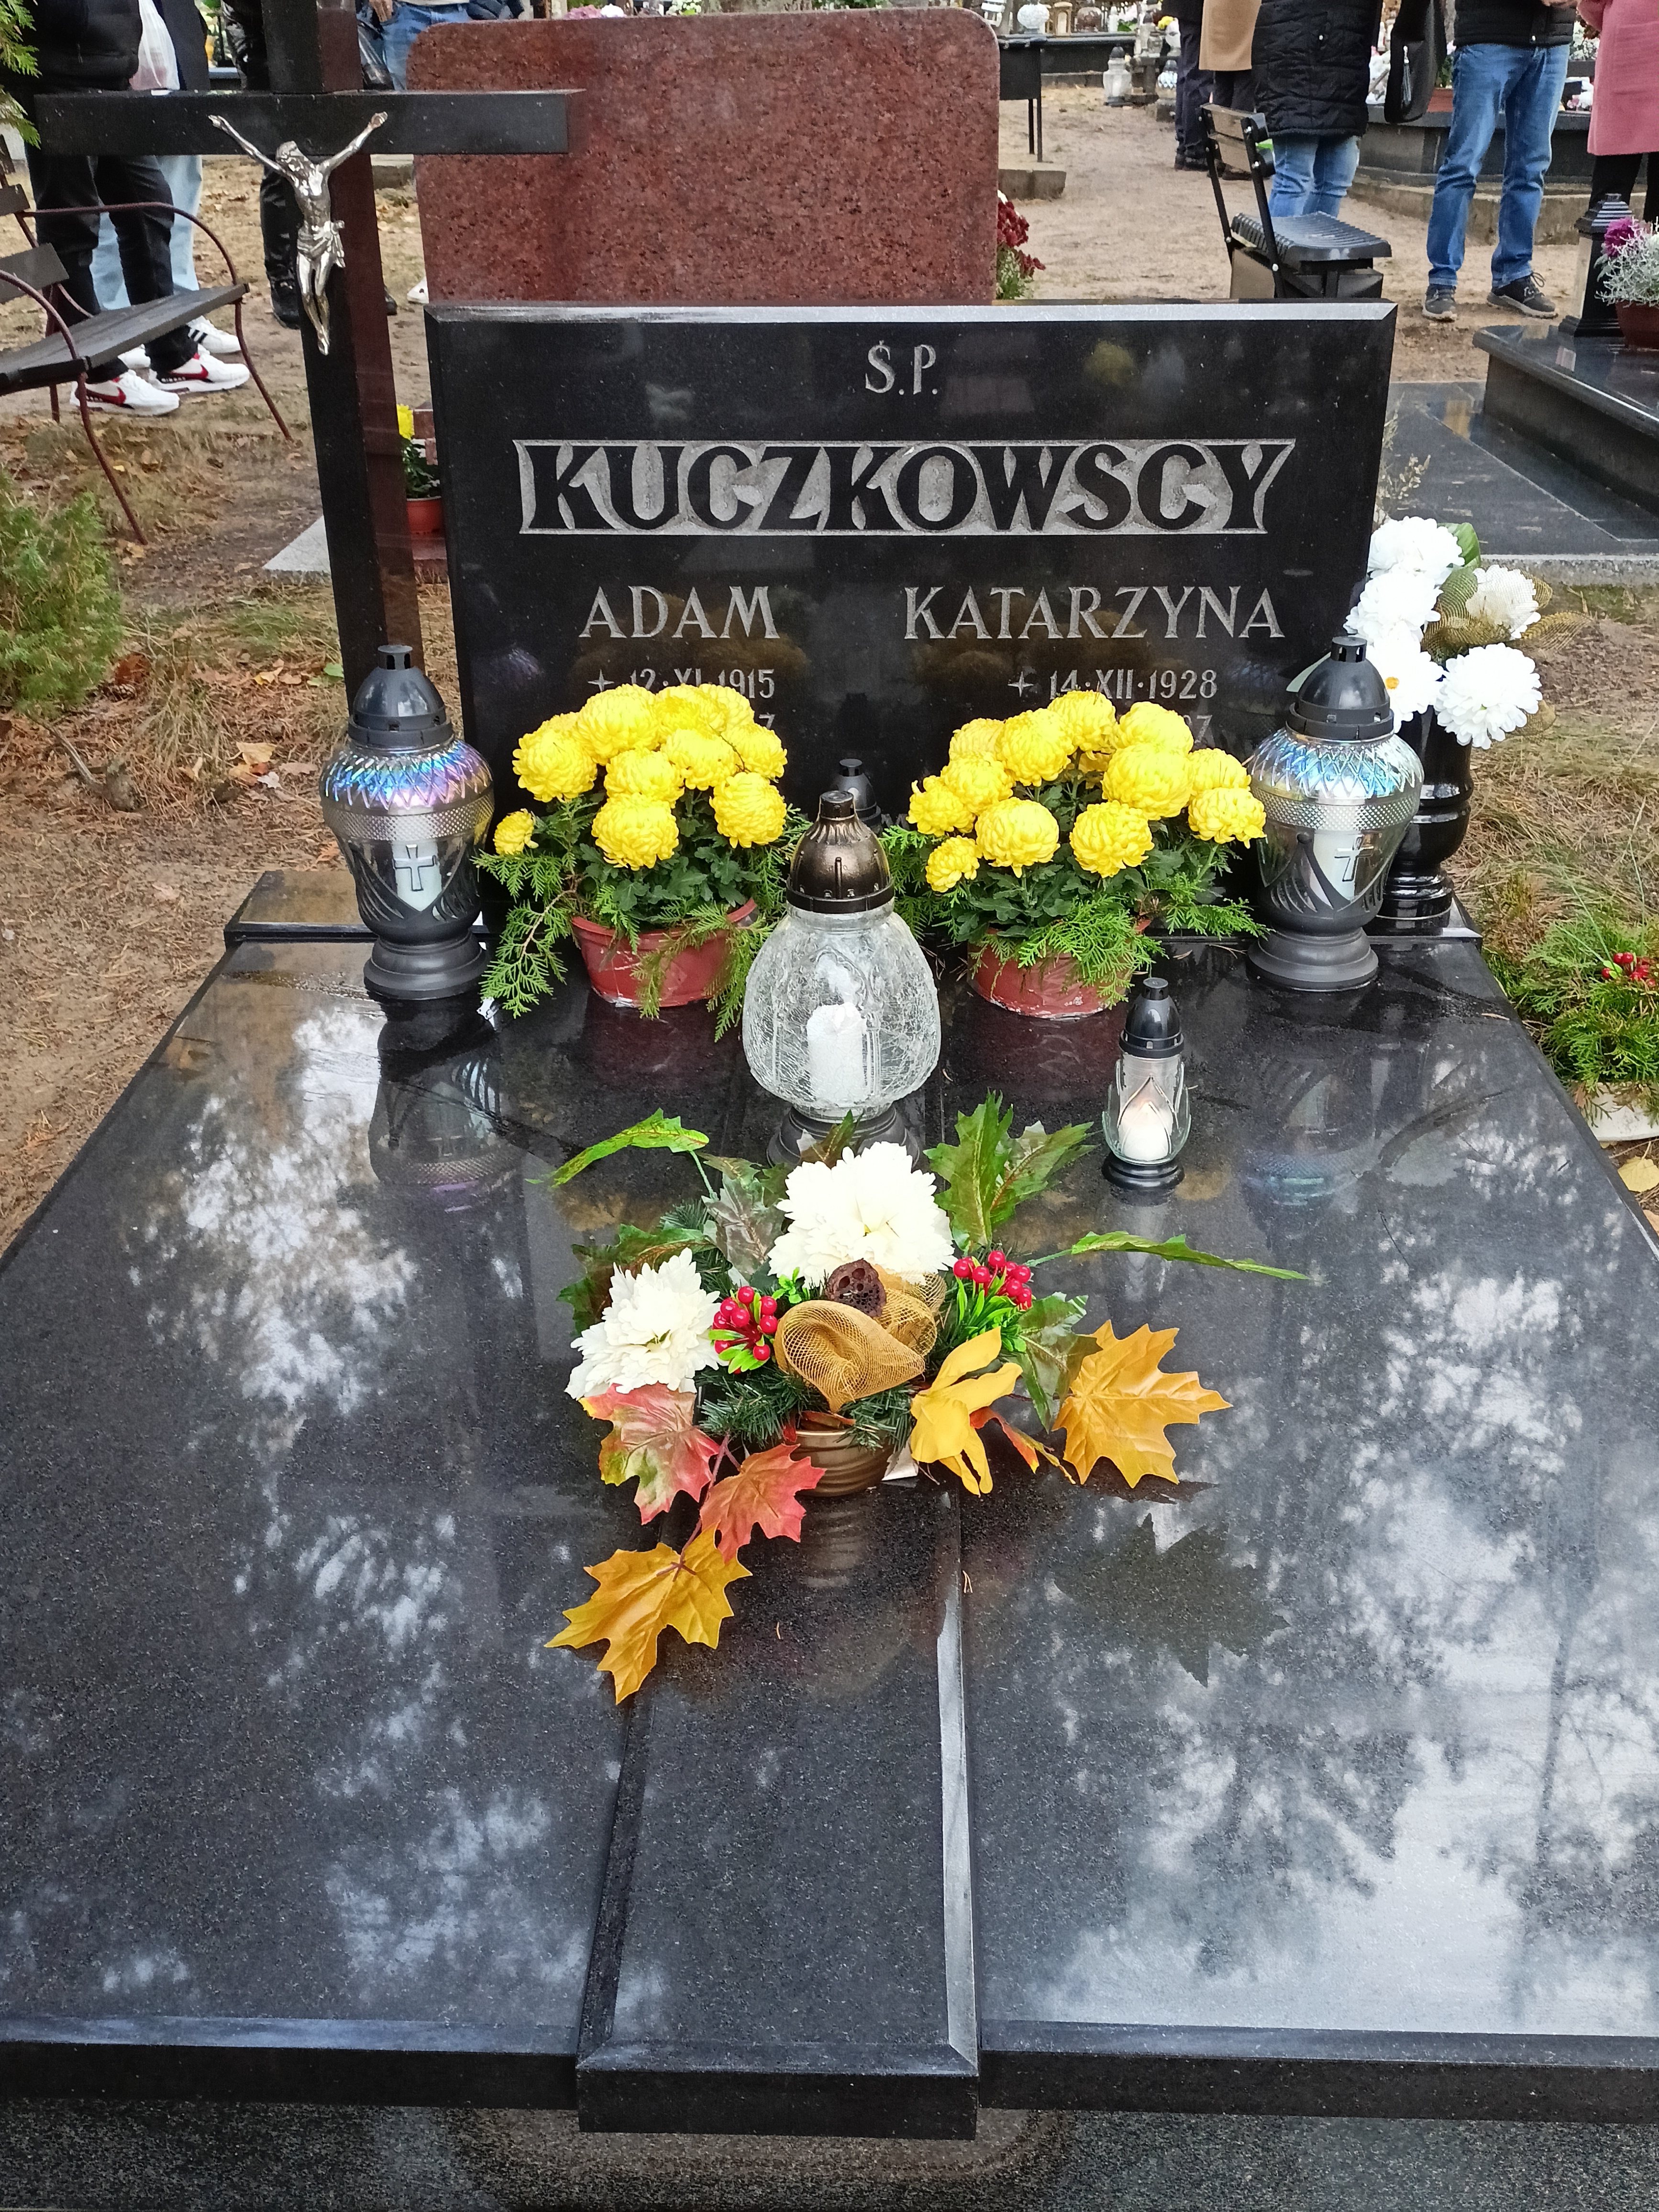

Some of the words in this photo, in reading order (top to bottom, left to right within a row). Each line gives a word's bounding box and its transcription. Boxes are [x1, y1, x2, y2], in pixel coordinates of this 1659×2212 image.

[513, 440, 1295, 535] KUCZKOWSCY
[578, 585, 780, 639] ADAM
[904, 585, 1285, 639] KATARZYNA
